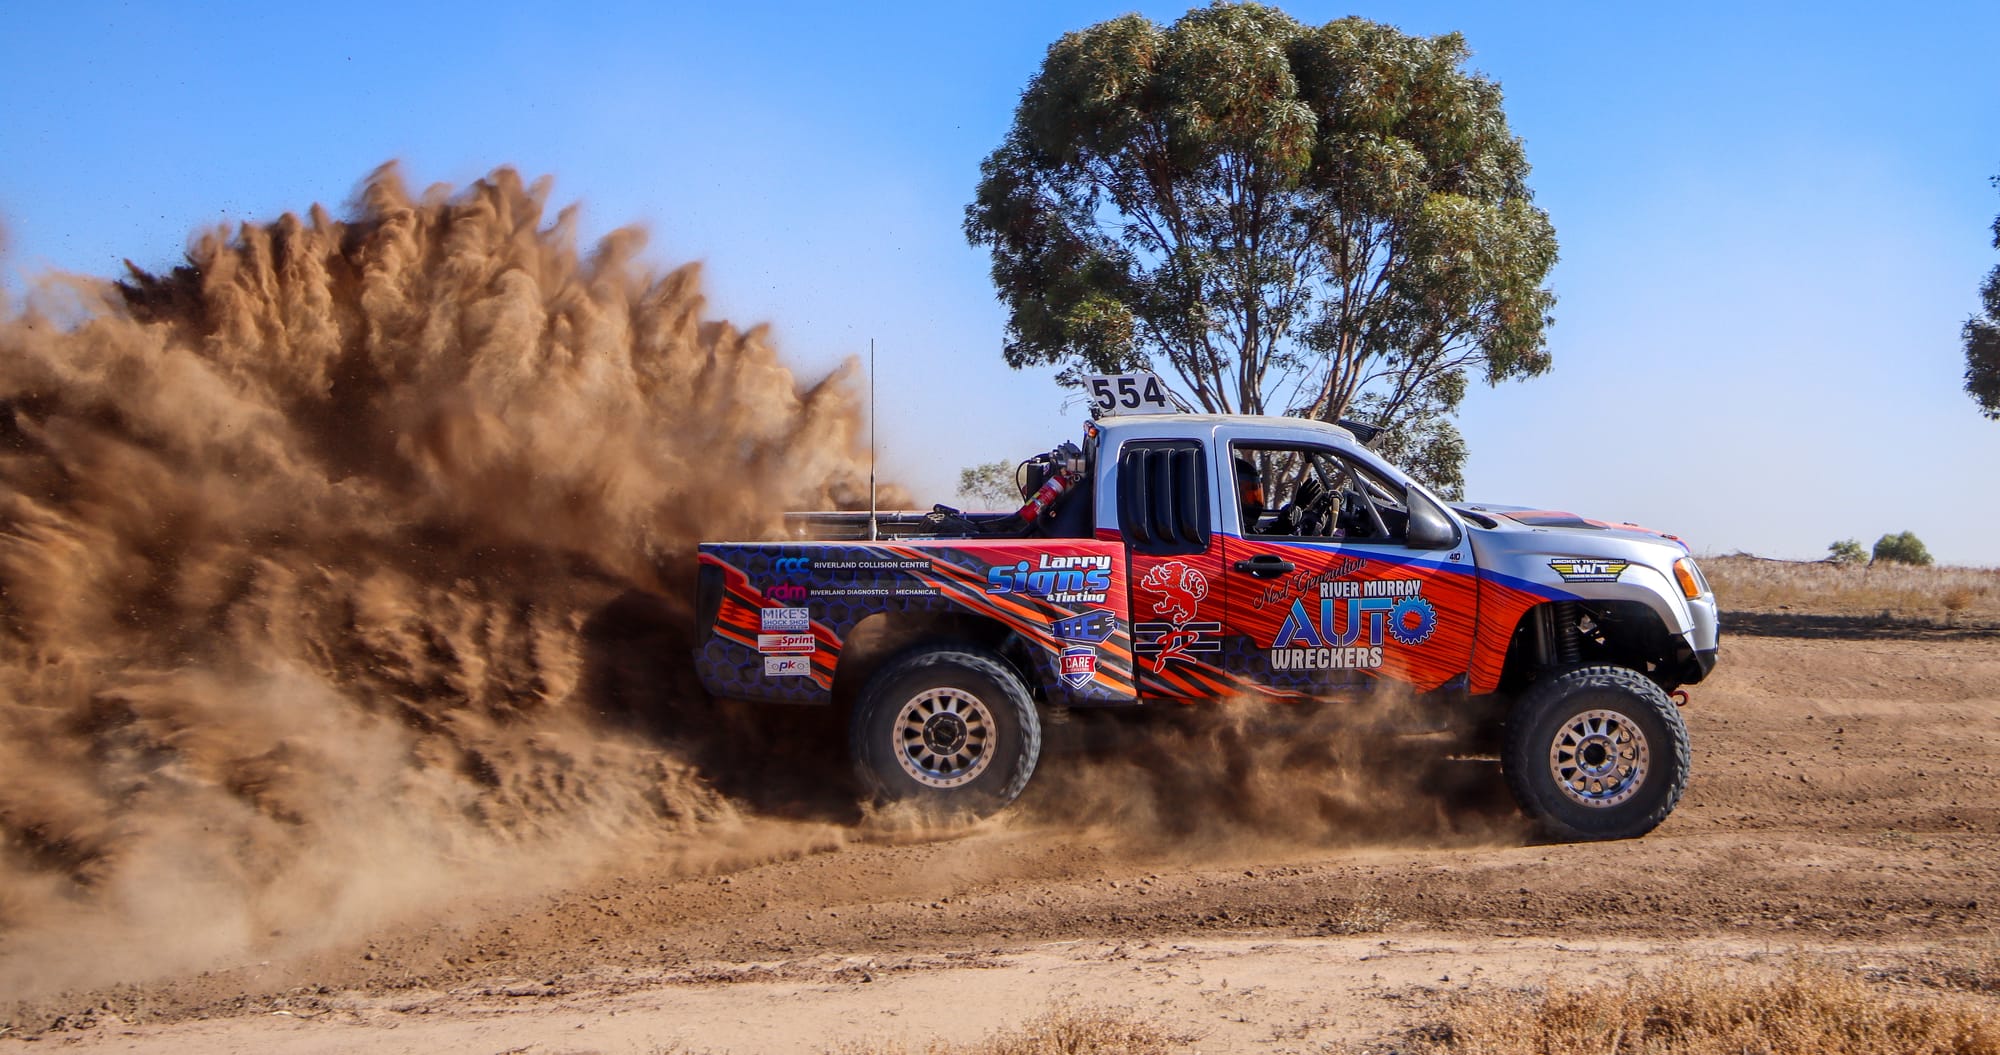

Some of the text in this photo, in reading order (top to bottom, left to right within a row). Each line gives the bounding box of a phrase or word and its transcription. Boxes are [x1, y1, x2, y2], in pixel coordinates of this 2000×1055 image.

[1092, 377, 1166, 409] 554
[858, 561, 898, 569] COLLISION
[900, 561, 929, 569] CENTRE
[1040, 554, 1111, 569] Larry
[1572, 564, 1610, 574] M/T
[986, 561, 1112, 596] Signs
[1253, 557, 1368, 610] Next Generation
[766, 582, 807, 600] rdm
[1320, 580, 1422, 598] RIVER MURRAY
[763, 609, 808, 619] MIKE'S
[1272, 596, 1437, 647] AUTO
[782, 636, 813, 645] Sprint
[779, 660, 797, 672] pk
[1065, 656, 1091, 669] CARE
[1271, 647, 1384, 670] WRECKERS
